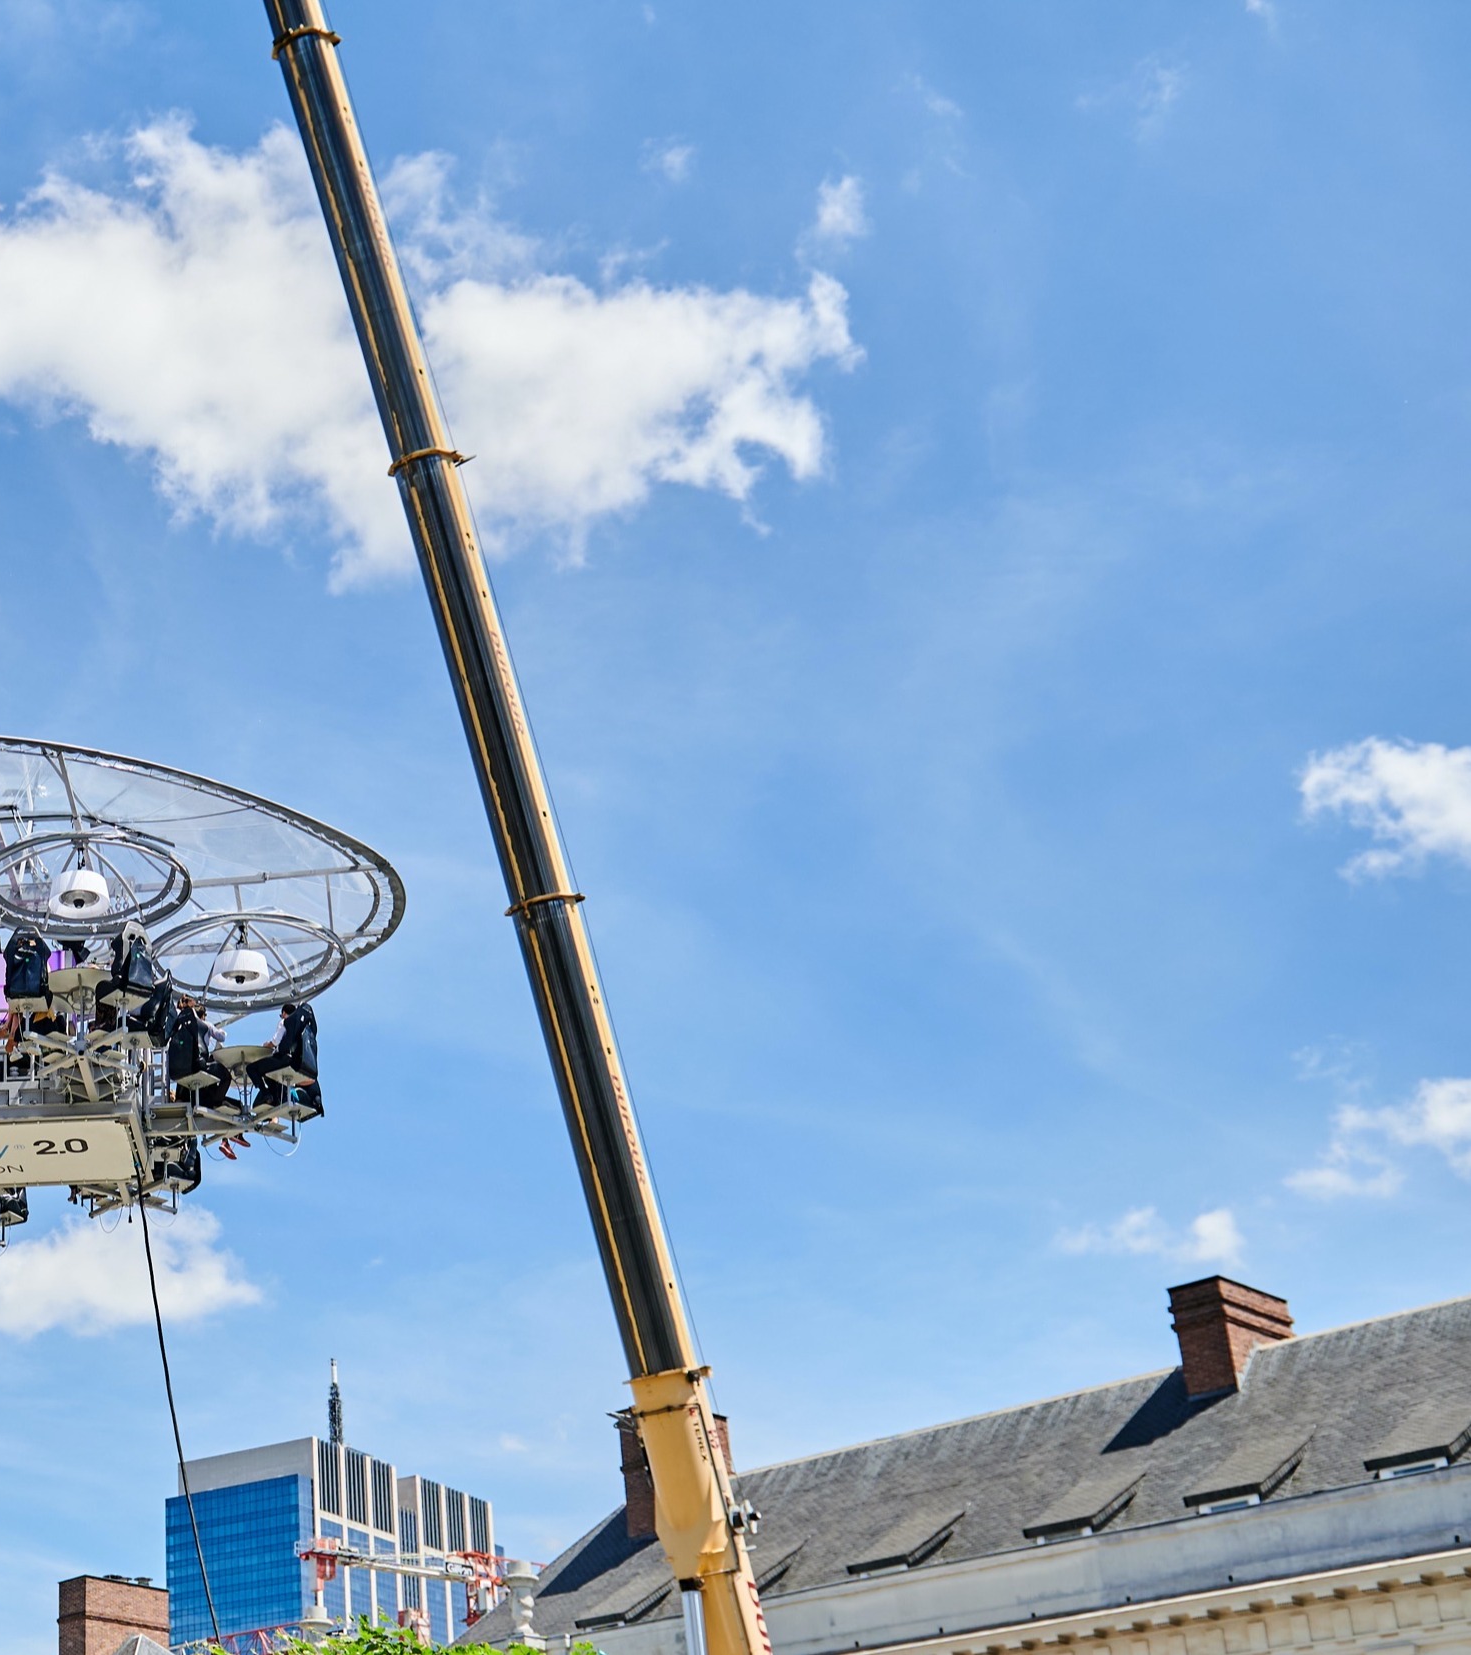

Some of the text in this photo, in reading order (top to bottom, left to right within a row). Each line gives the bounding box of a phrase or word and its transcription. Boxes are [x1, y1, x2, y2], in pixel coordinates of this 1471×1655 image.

[489, 629, 525, 736] DUFOUR
[33, 1138, 89, 1155] 2.0
[611, 1073, 646, 1185] DUFOUR
[693, 1422, 709, 1464] TEREX
